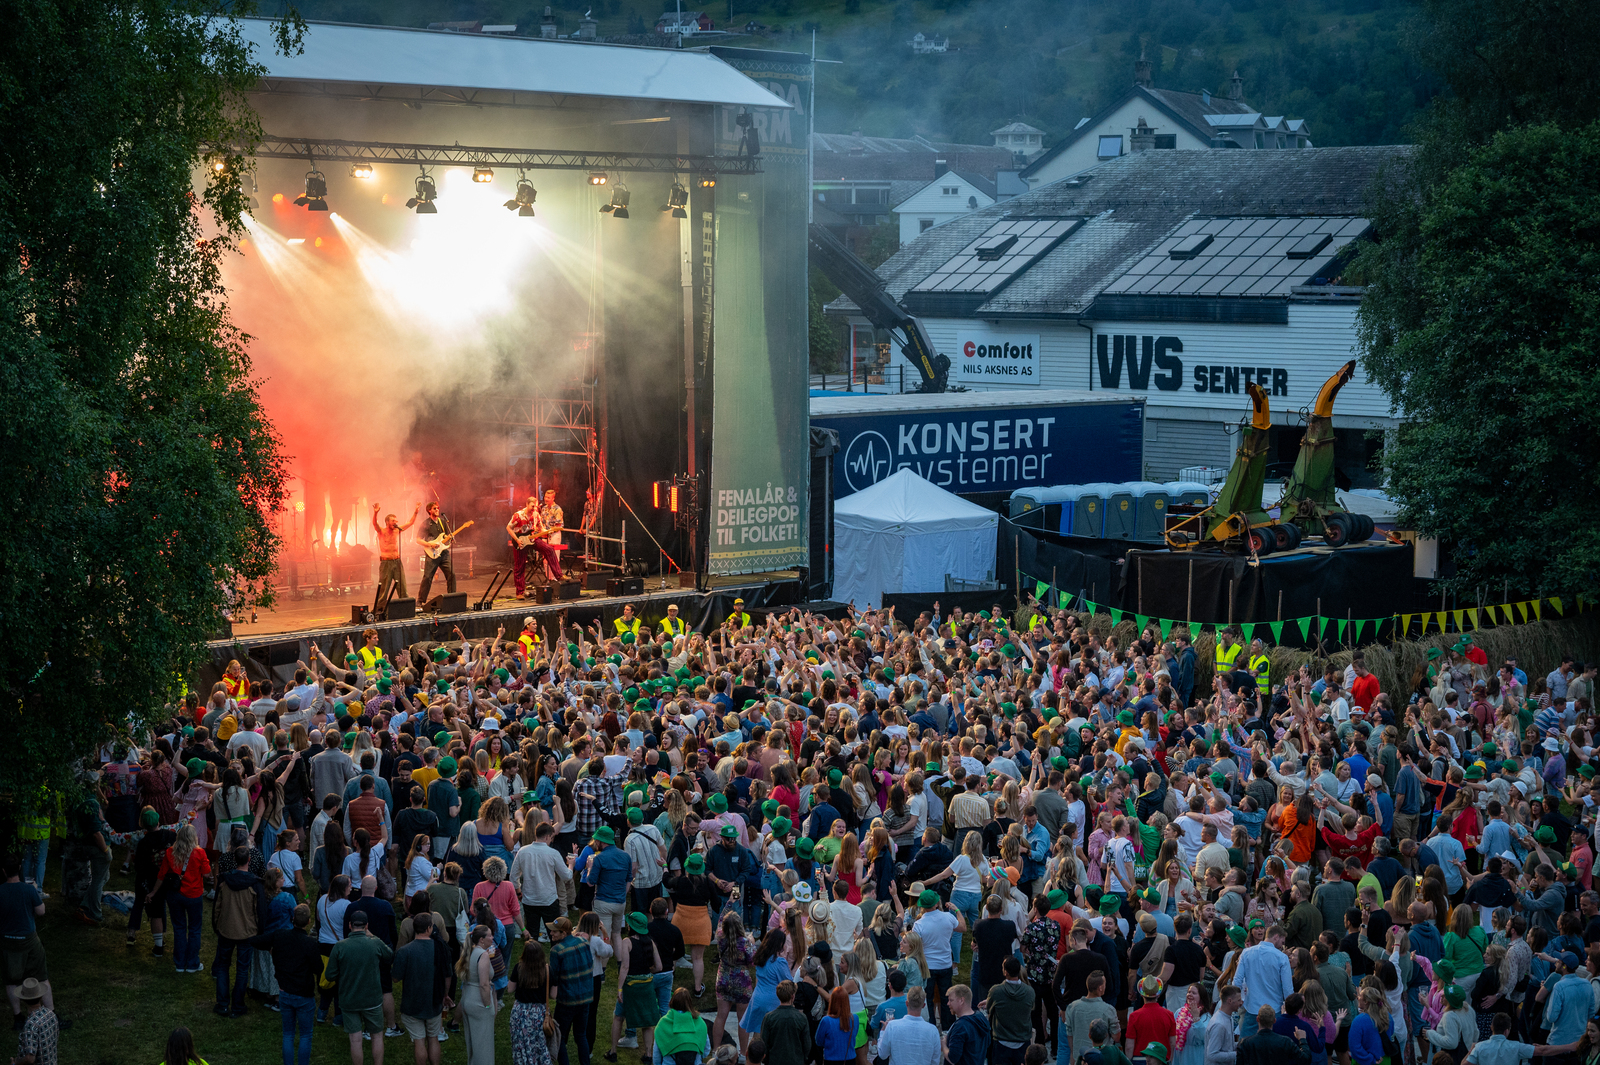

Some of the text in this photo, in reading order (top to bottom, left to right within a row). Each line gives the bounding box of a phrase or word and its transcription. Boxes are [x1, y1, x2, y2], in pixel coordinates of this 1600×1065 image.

[963, 340, 1033, 360] Comfort
[963, 364, 1033, 376] NILS AKSNES AS
[1097, 334, 1288, 396] VVS SENTER
[898, 417, 1056, 455] KONSERT
[718, 481, 798, 507] FENALÅR &
[717, 505, 799, 526] DEILEGPOP
[716, 523, 798, 545] TIL FOLKET!
